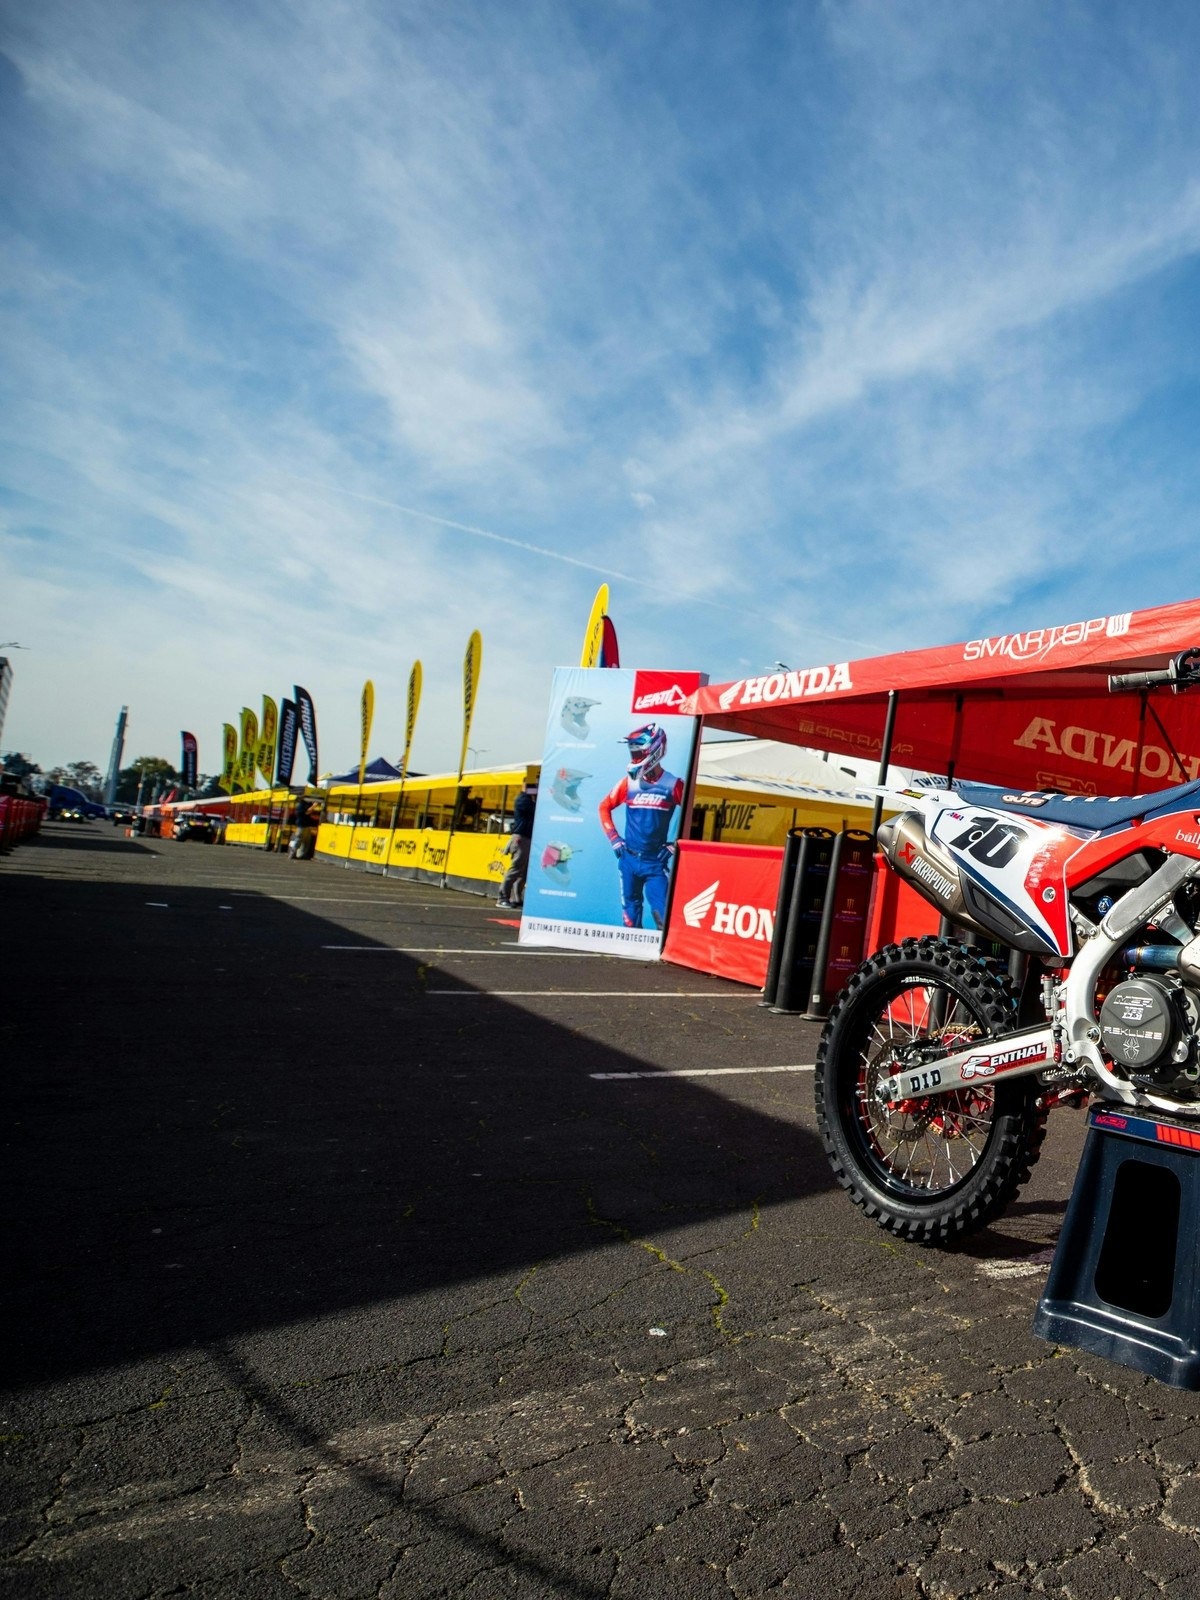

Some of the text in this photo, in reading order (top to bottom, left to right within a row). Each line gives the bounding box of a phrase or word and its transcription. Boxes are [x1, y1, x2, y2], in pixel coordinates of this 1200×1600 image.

[963, 617, 1106, 661] SMARTOP
[739, 662, 852, 705] HONDA
[280, 708, 296, 777] PROGRESSIVE
[632, 792, 668, 805] LEATT
[1002, 794, 1046, 806] GUTS
[949, 816, 1030, 869] 10
[910, 856, 957, 900] AKRAPOVIČ
[528, 922, 561, 933] ULTIMATE
[563, 926, 581, 936] HEAD
[592, 930, 614, 939] BRAIN
[616, 932, 660, 944] PROTECTION
[711, 900, 778, 943] HON
